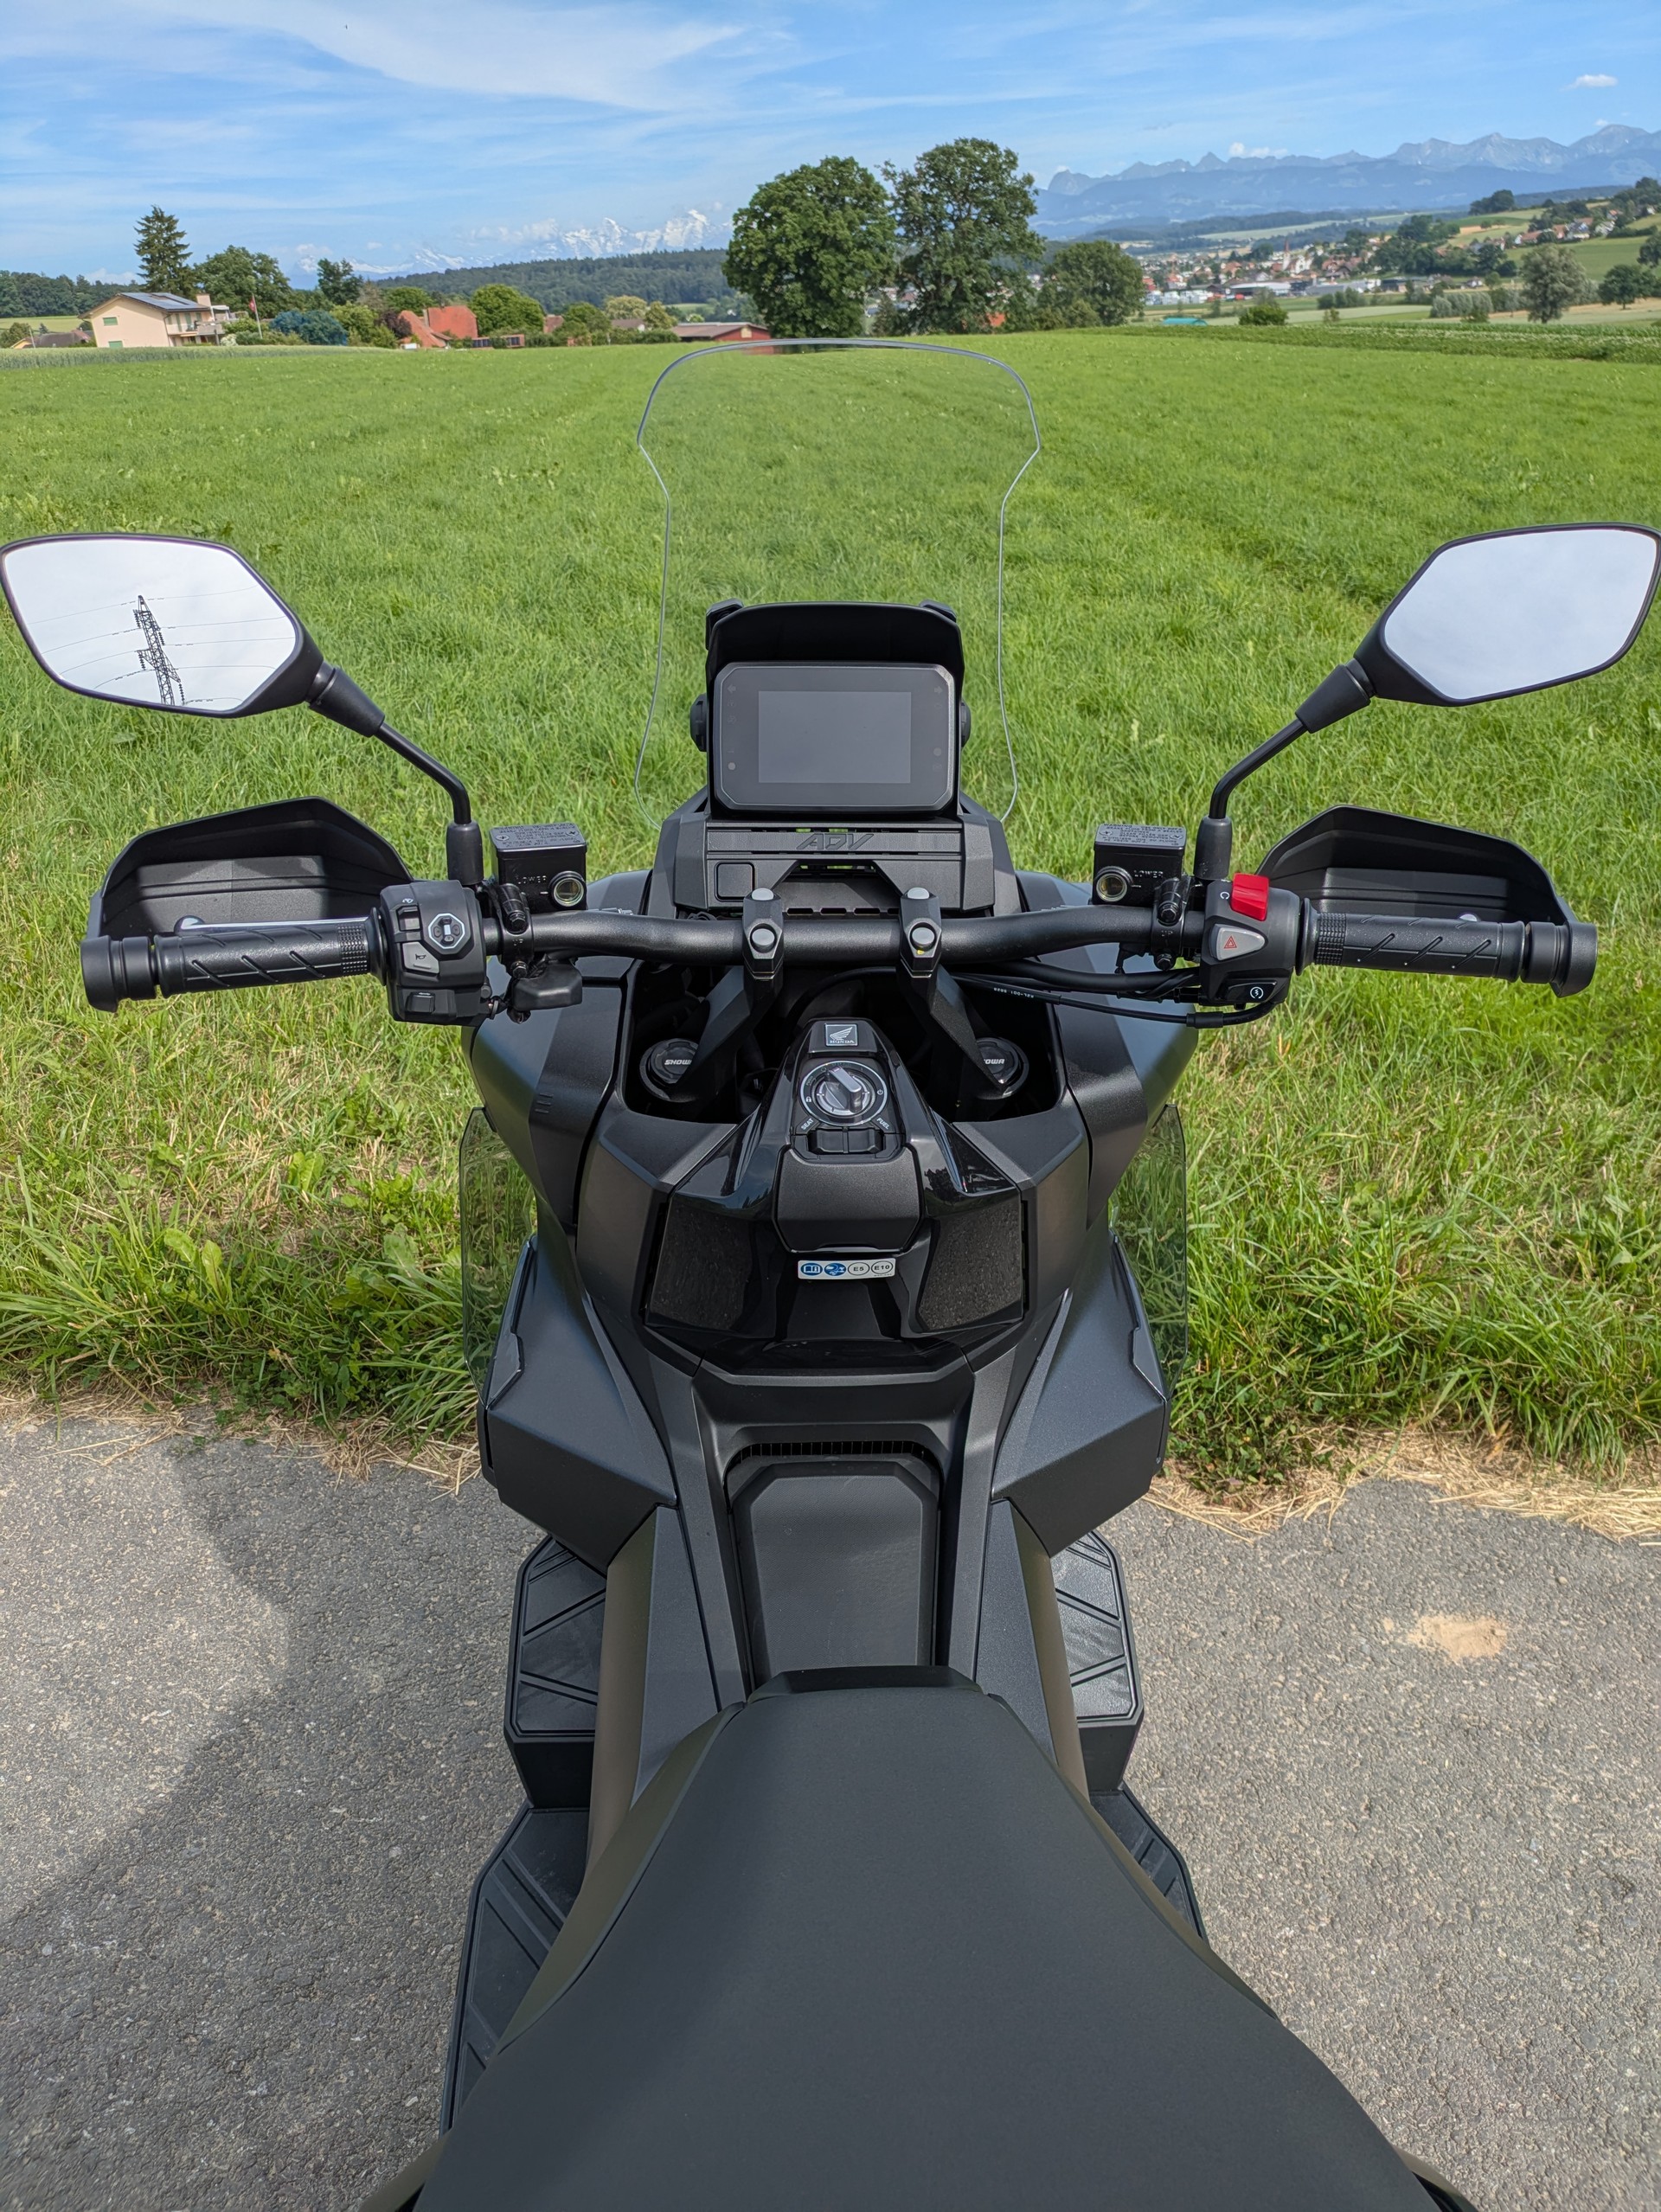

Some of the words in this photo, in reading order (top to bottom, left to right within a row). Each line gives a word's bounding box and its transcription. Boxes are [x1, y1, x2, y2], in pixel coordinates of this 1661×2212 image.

[796, 833, 874, 850] ADV
[516, 875, 547, 884] LOWER
[1133, 869, 1164, 878] LOWER
[801, 1118, 814, 1130] SEAT
[876, 1117, 890, 1130] FUEL
